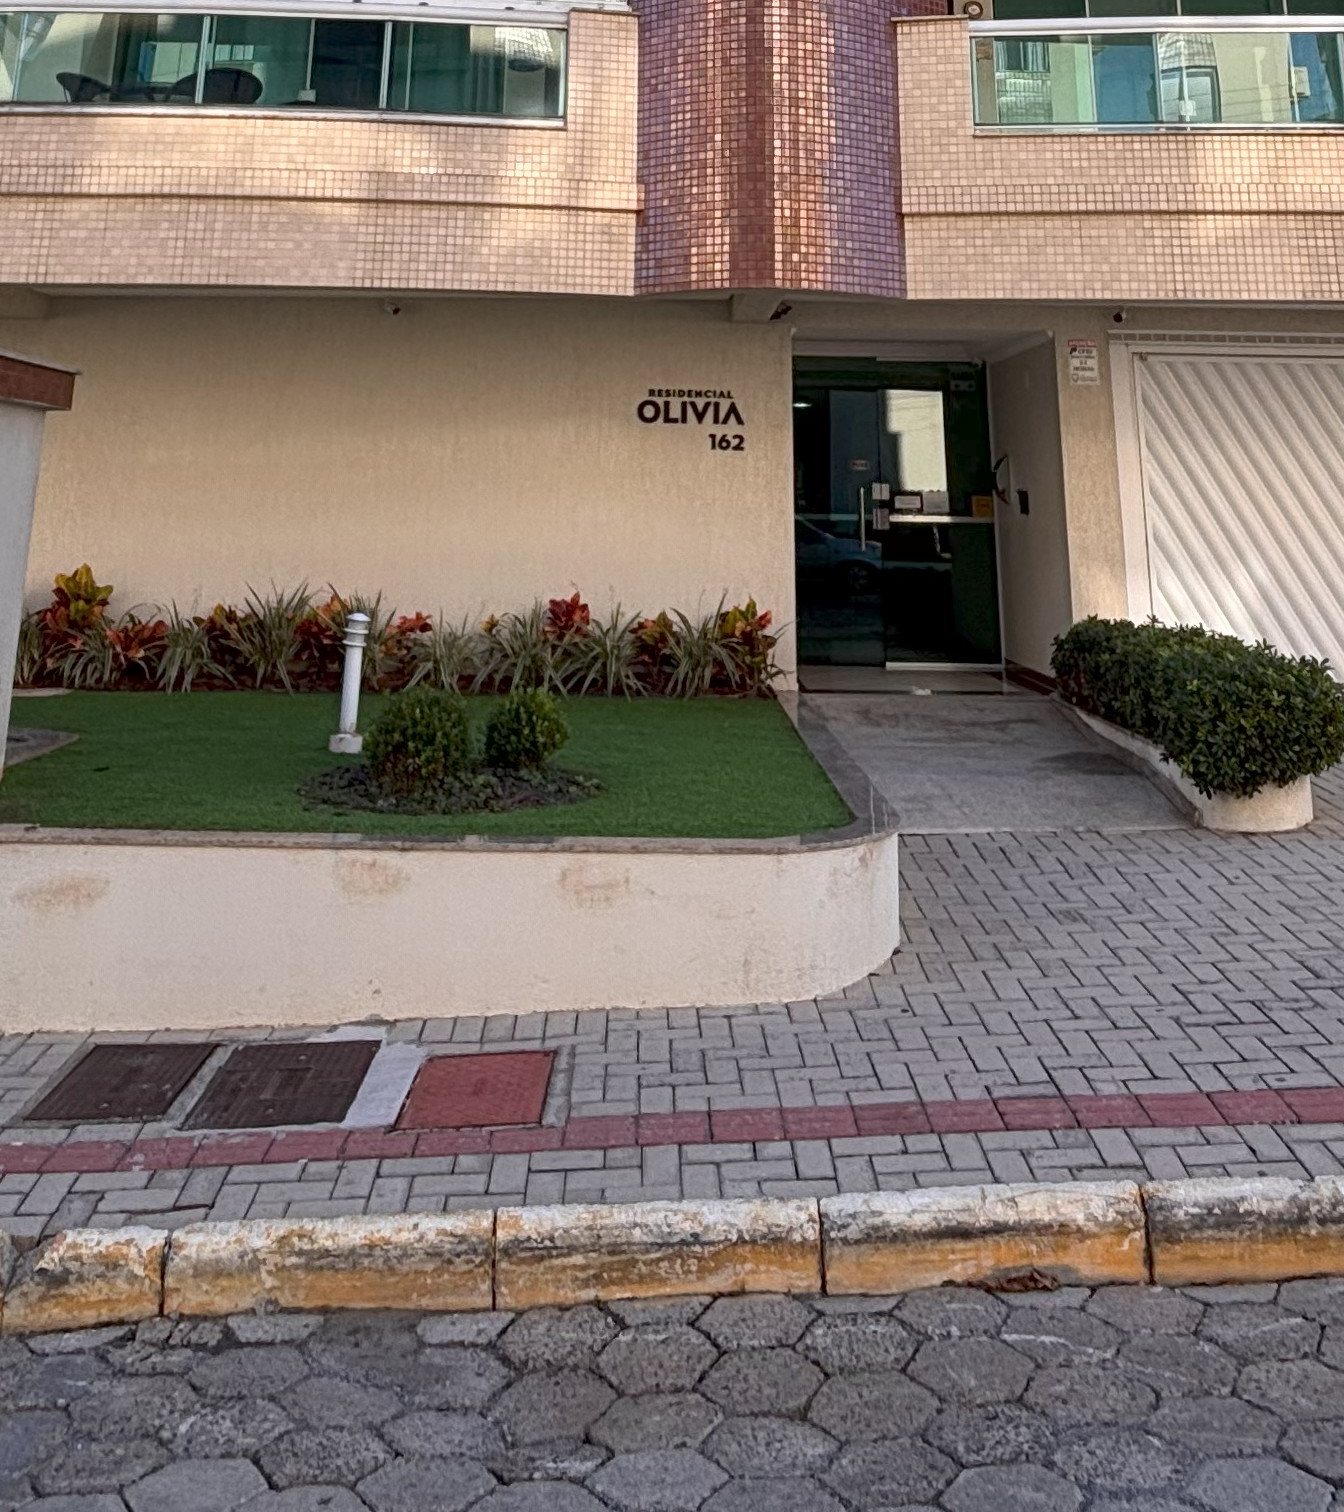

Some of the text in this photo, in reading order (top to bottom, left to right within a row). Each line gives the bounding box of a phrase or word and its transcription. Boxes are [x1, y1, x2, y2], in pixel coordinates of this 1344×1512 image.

[648, 389, 734, 399] RESIDENCIAL
[637, 399, 745, 425] OLIVIA
[709, 434, 745, 451] 162
